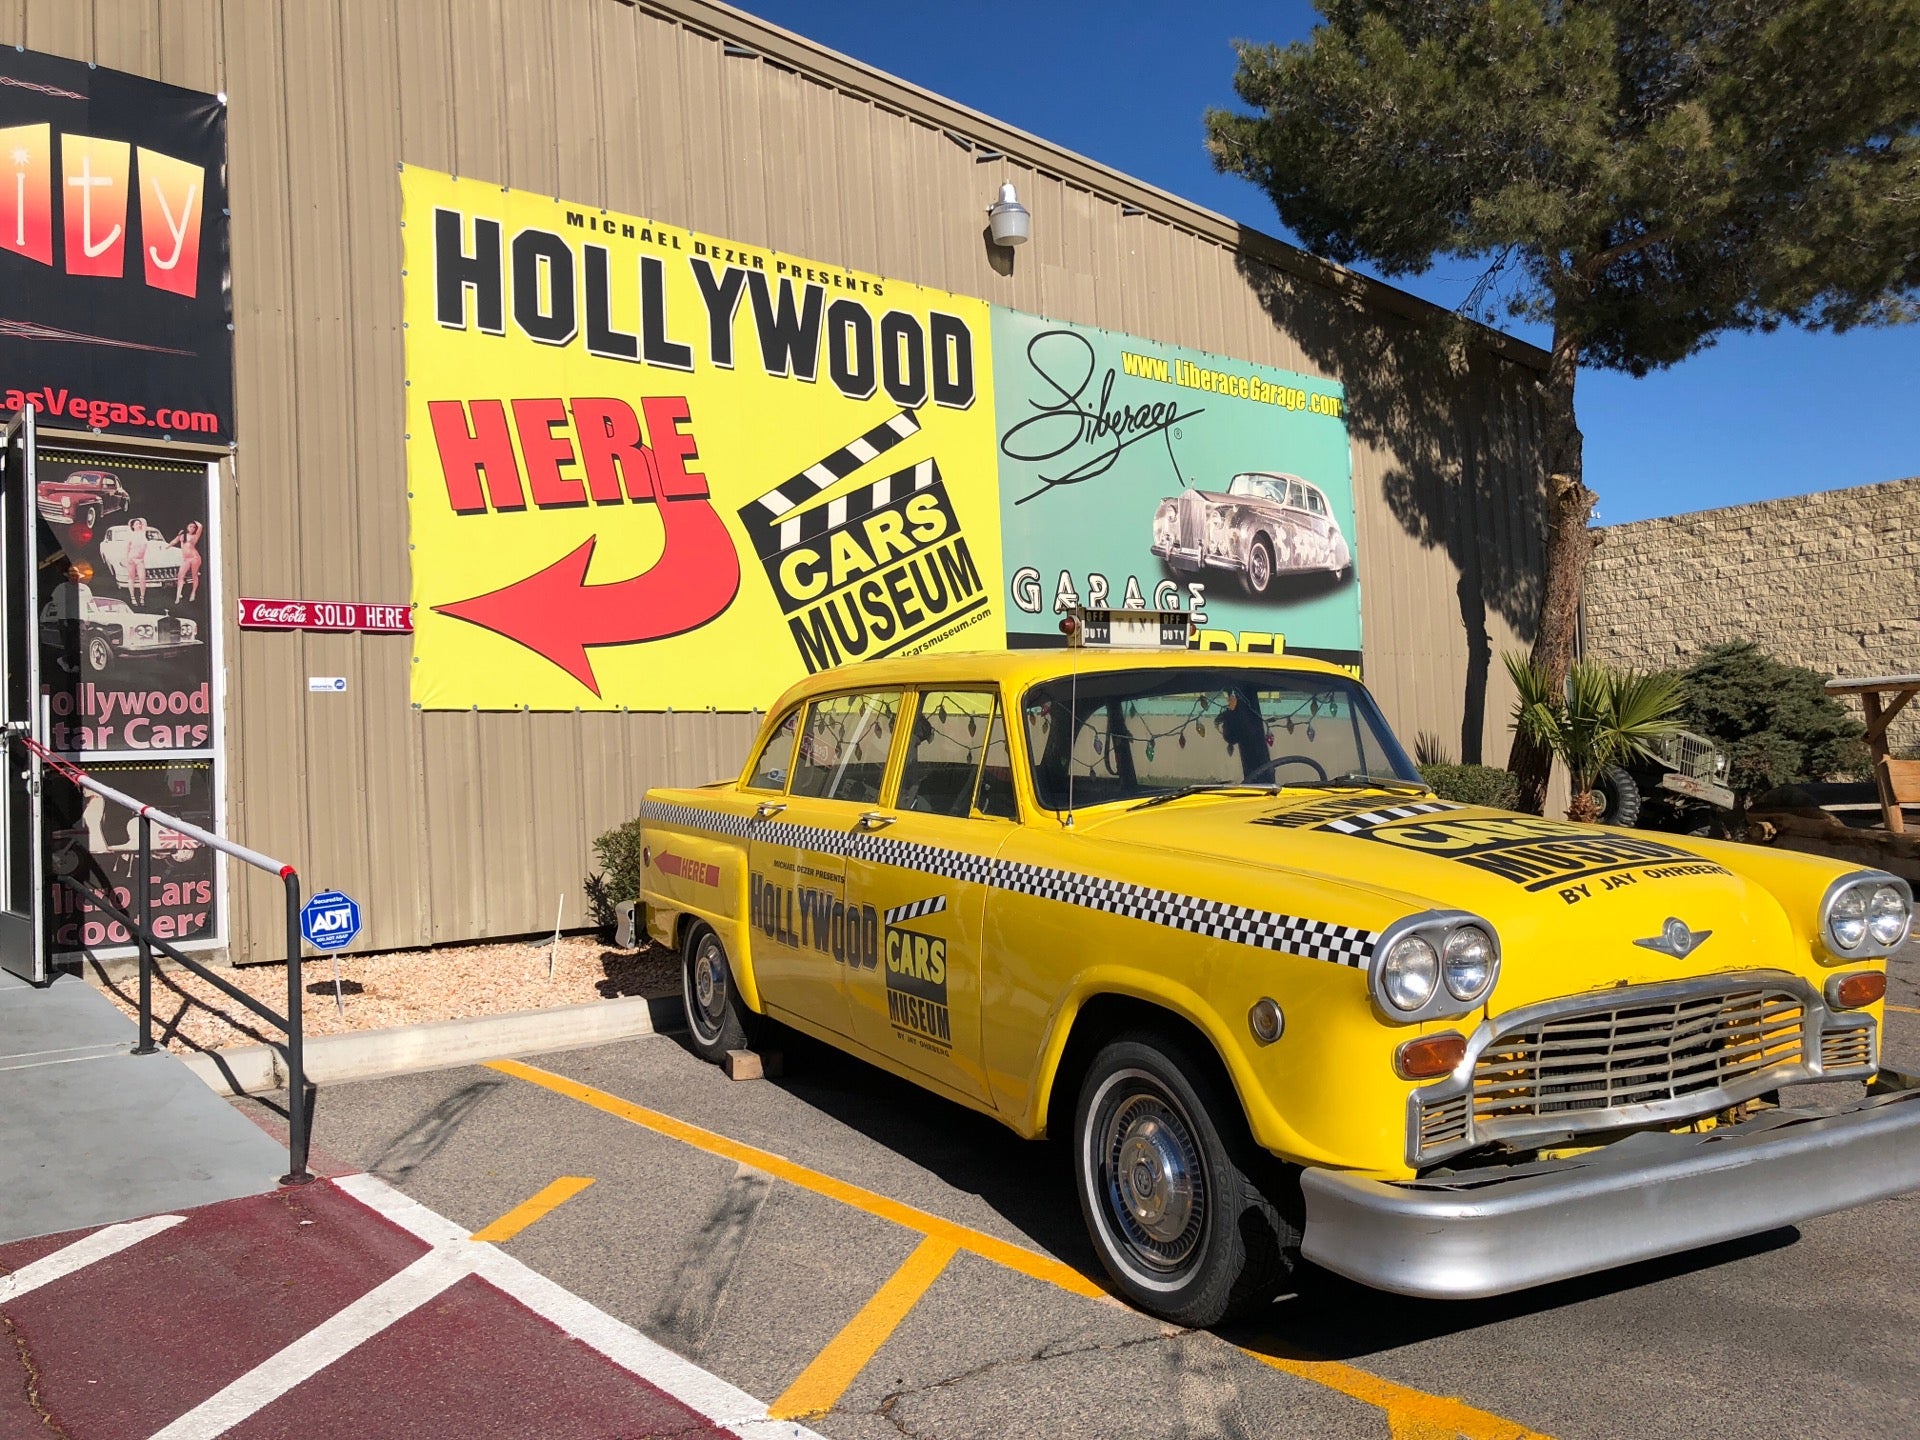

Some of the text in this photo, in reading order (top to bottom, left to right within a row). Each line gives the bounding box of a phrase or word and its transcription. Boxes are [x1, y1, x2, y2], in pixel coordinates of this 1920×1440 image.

[566, 210, 884, 297] MICHAEL DEZER PRESENTS
[434, 206, 976, 411] HOLLYWOOD
[0, 386, 219, 433] asVegas.com
[427, 395, 711, 517] HERE
[779, 493, 948, 601] CARS
[787, 536, 984, 676] MUSEUM
[1011, 566, 1209, 624] GARAGE
[314, 604, 356, 627] SOLD
[365, 606, 405, 628] HERE
[1084, 627, 1108, 639] DUTY
[1086, 611, 1105, 623] OFF
[1115, 616, 1155, 633] TAXI
[1162, 629, 1185, 641] DUTY
[1163, 614, 1181, 625] OFF
[52, 717, 209, 751] tar Cars
[1371, 817, 1608, 851] CARS
[681, 857, 707, 884] HERE
[773, 859, 846, 884] MICHAEL DEZER PRESENTS
[1453, 838, 1704, 885] MUSEUM
[1558, 864, 1735, 905] BY JAY OHRBERG
[311, 909, 350, 932] ADT
[751, 870, 880, 972] HOLLYWOOD
[886, 930, 946, 985] CARS
[887, 989, 951, 1042] MUSEUM
